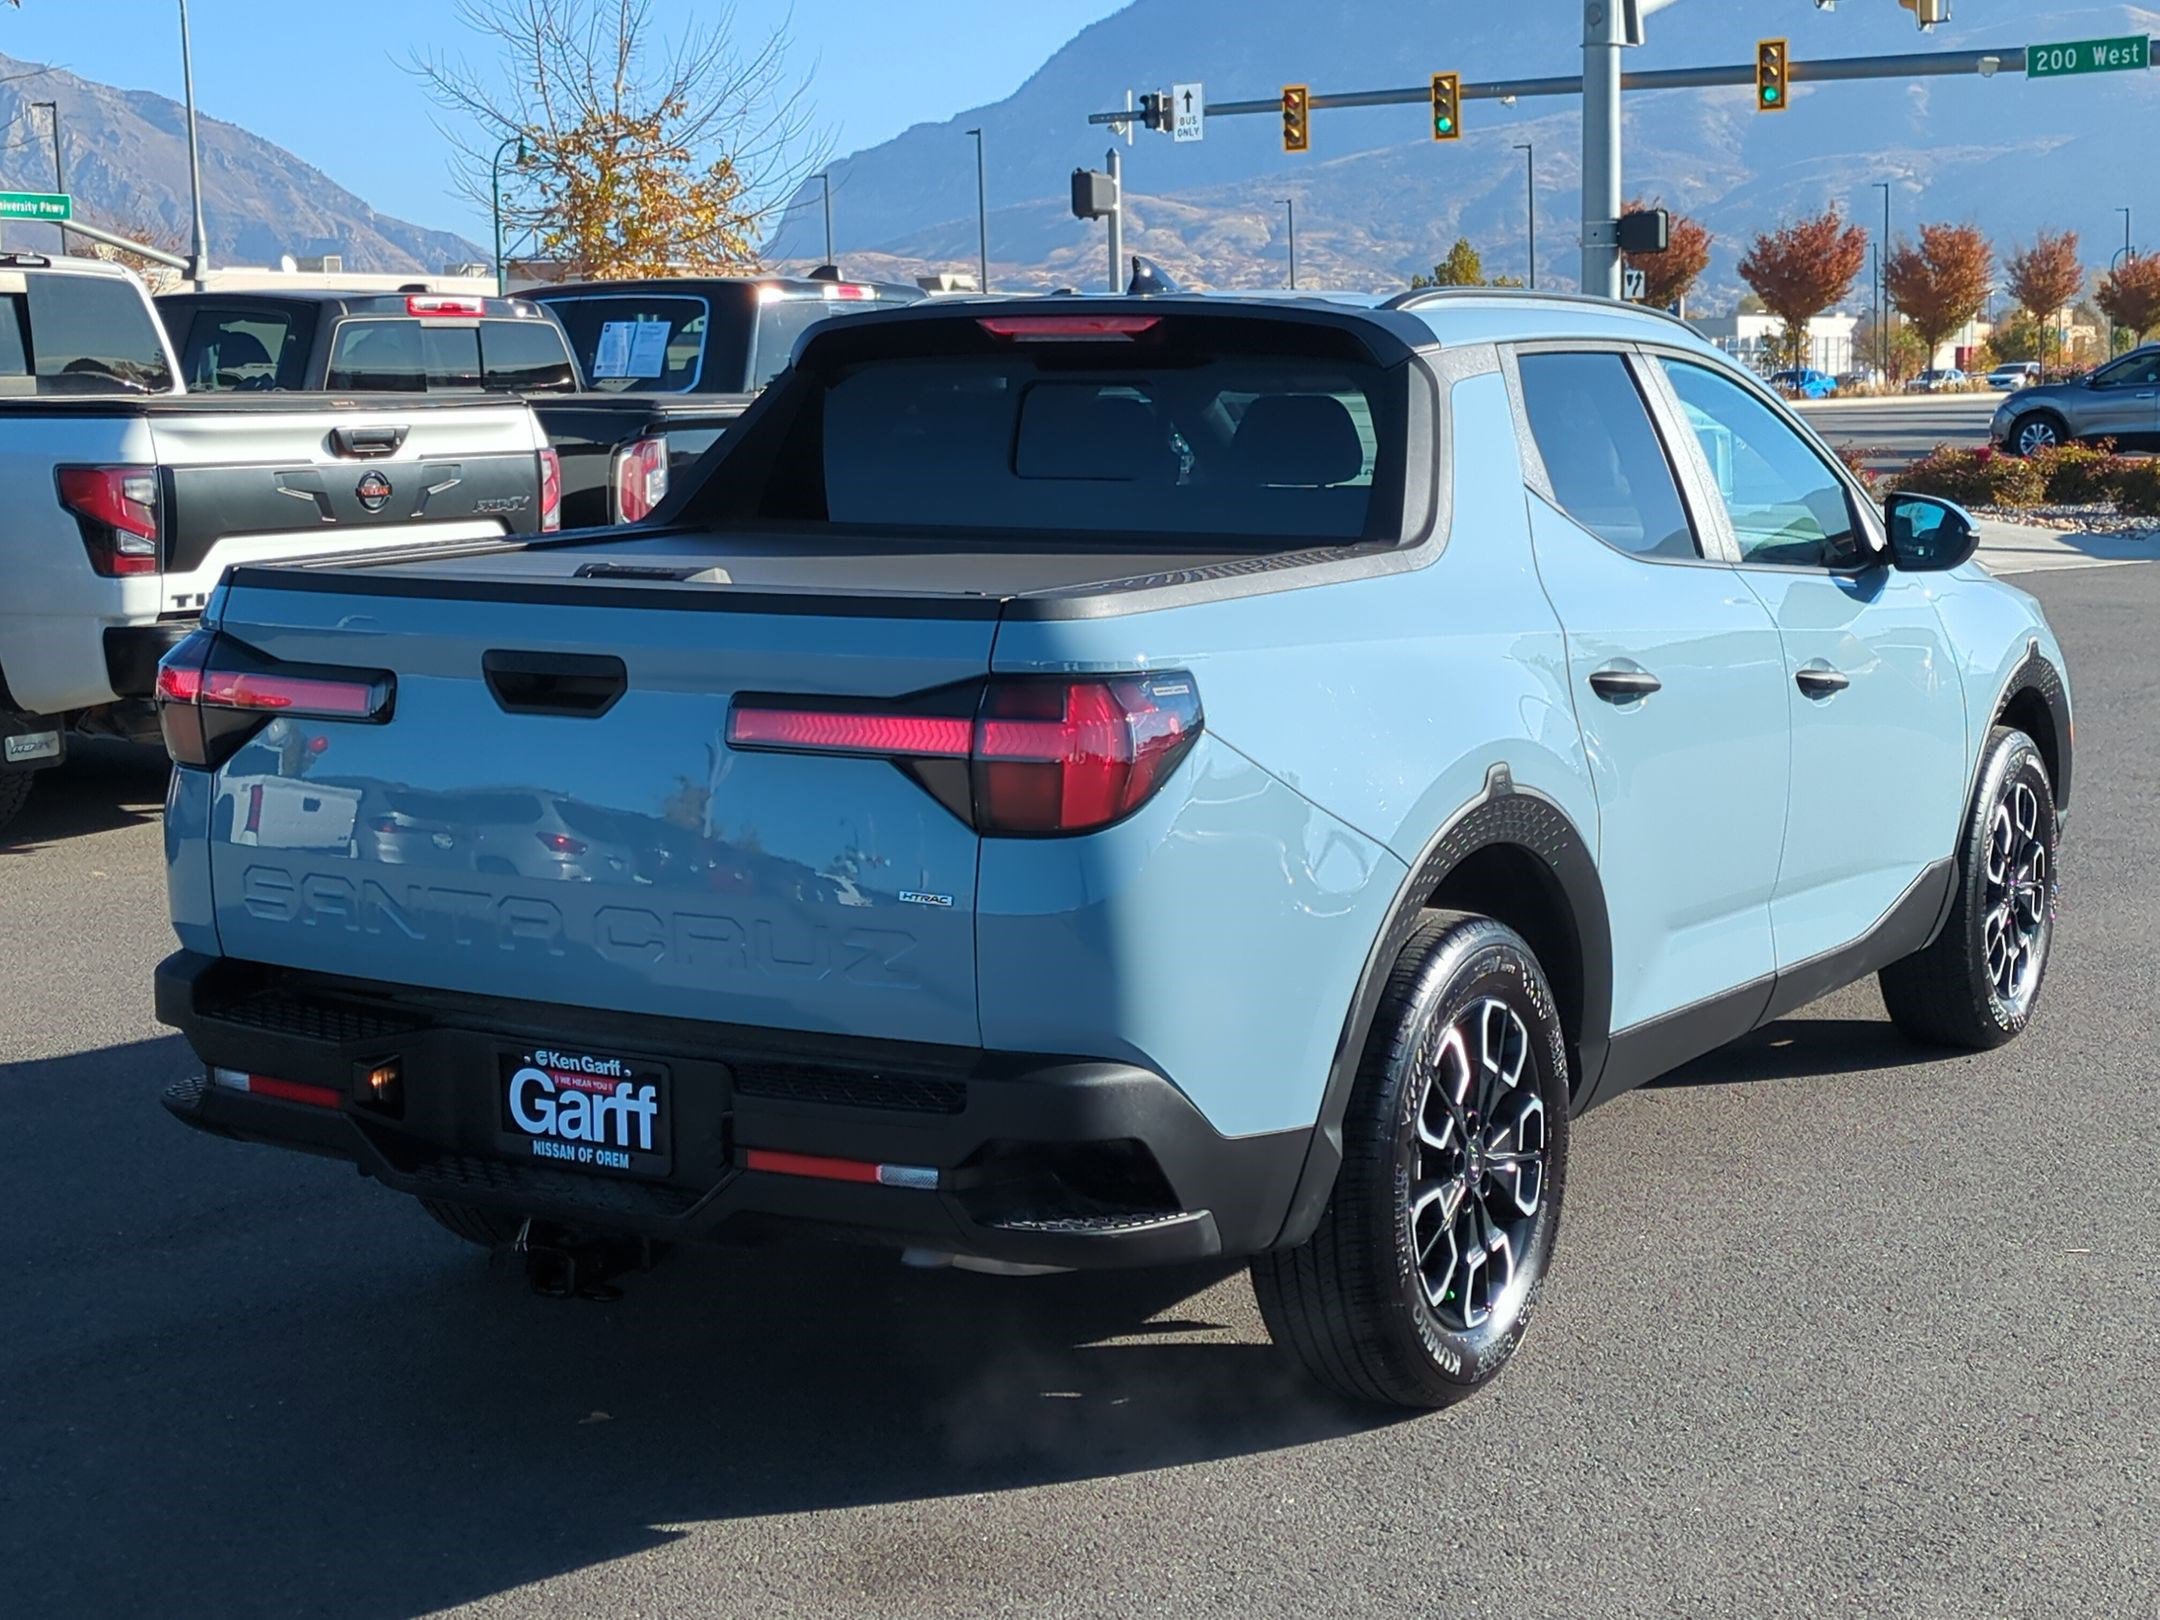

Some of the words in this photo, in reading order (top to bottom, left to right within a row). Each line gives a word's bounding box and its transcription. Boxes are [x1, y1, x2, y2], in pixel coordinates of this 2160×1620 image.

[2036, 48, 2077, 71] 200
[2092, 43, 2140, 66] West
[1177, 126, 1200, 138] ONLY
[1180, 115, 1197, 126] BUS
[39, 201, 65, 216] Pkwy
[902, 892, 949, 905] HTRAC
[243, 863, 566, 957] SANTA
[594, 904, 922, 989] CRUZ
[549, 1051, 581, 1072] Ken
[581, 1055, 621, 1077] Garff
[560, 1076, 571, 1086] WE
[572, 1077, 592, 1088] HEAR
[592, 1081, 607, 1090] YOU
[509, 1067, 658, 1150] Garff
[532, 1140, 575, 1161] NISSAN
[578, 1147, 593, 1163] OF
[596, 1150, 630, 1169] OREM
[1412, 1304, 1463, 1376] KUMHO
